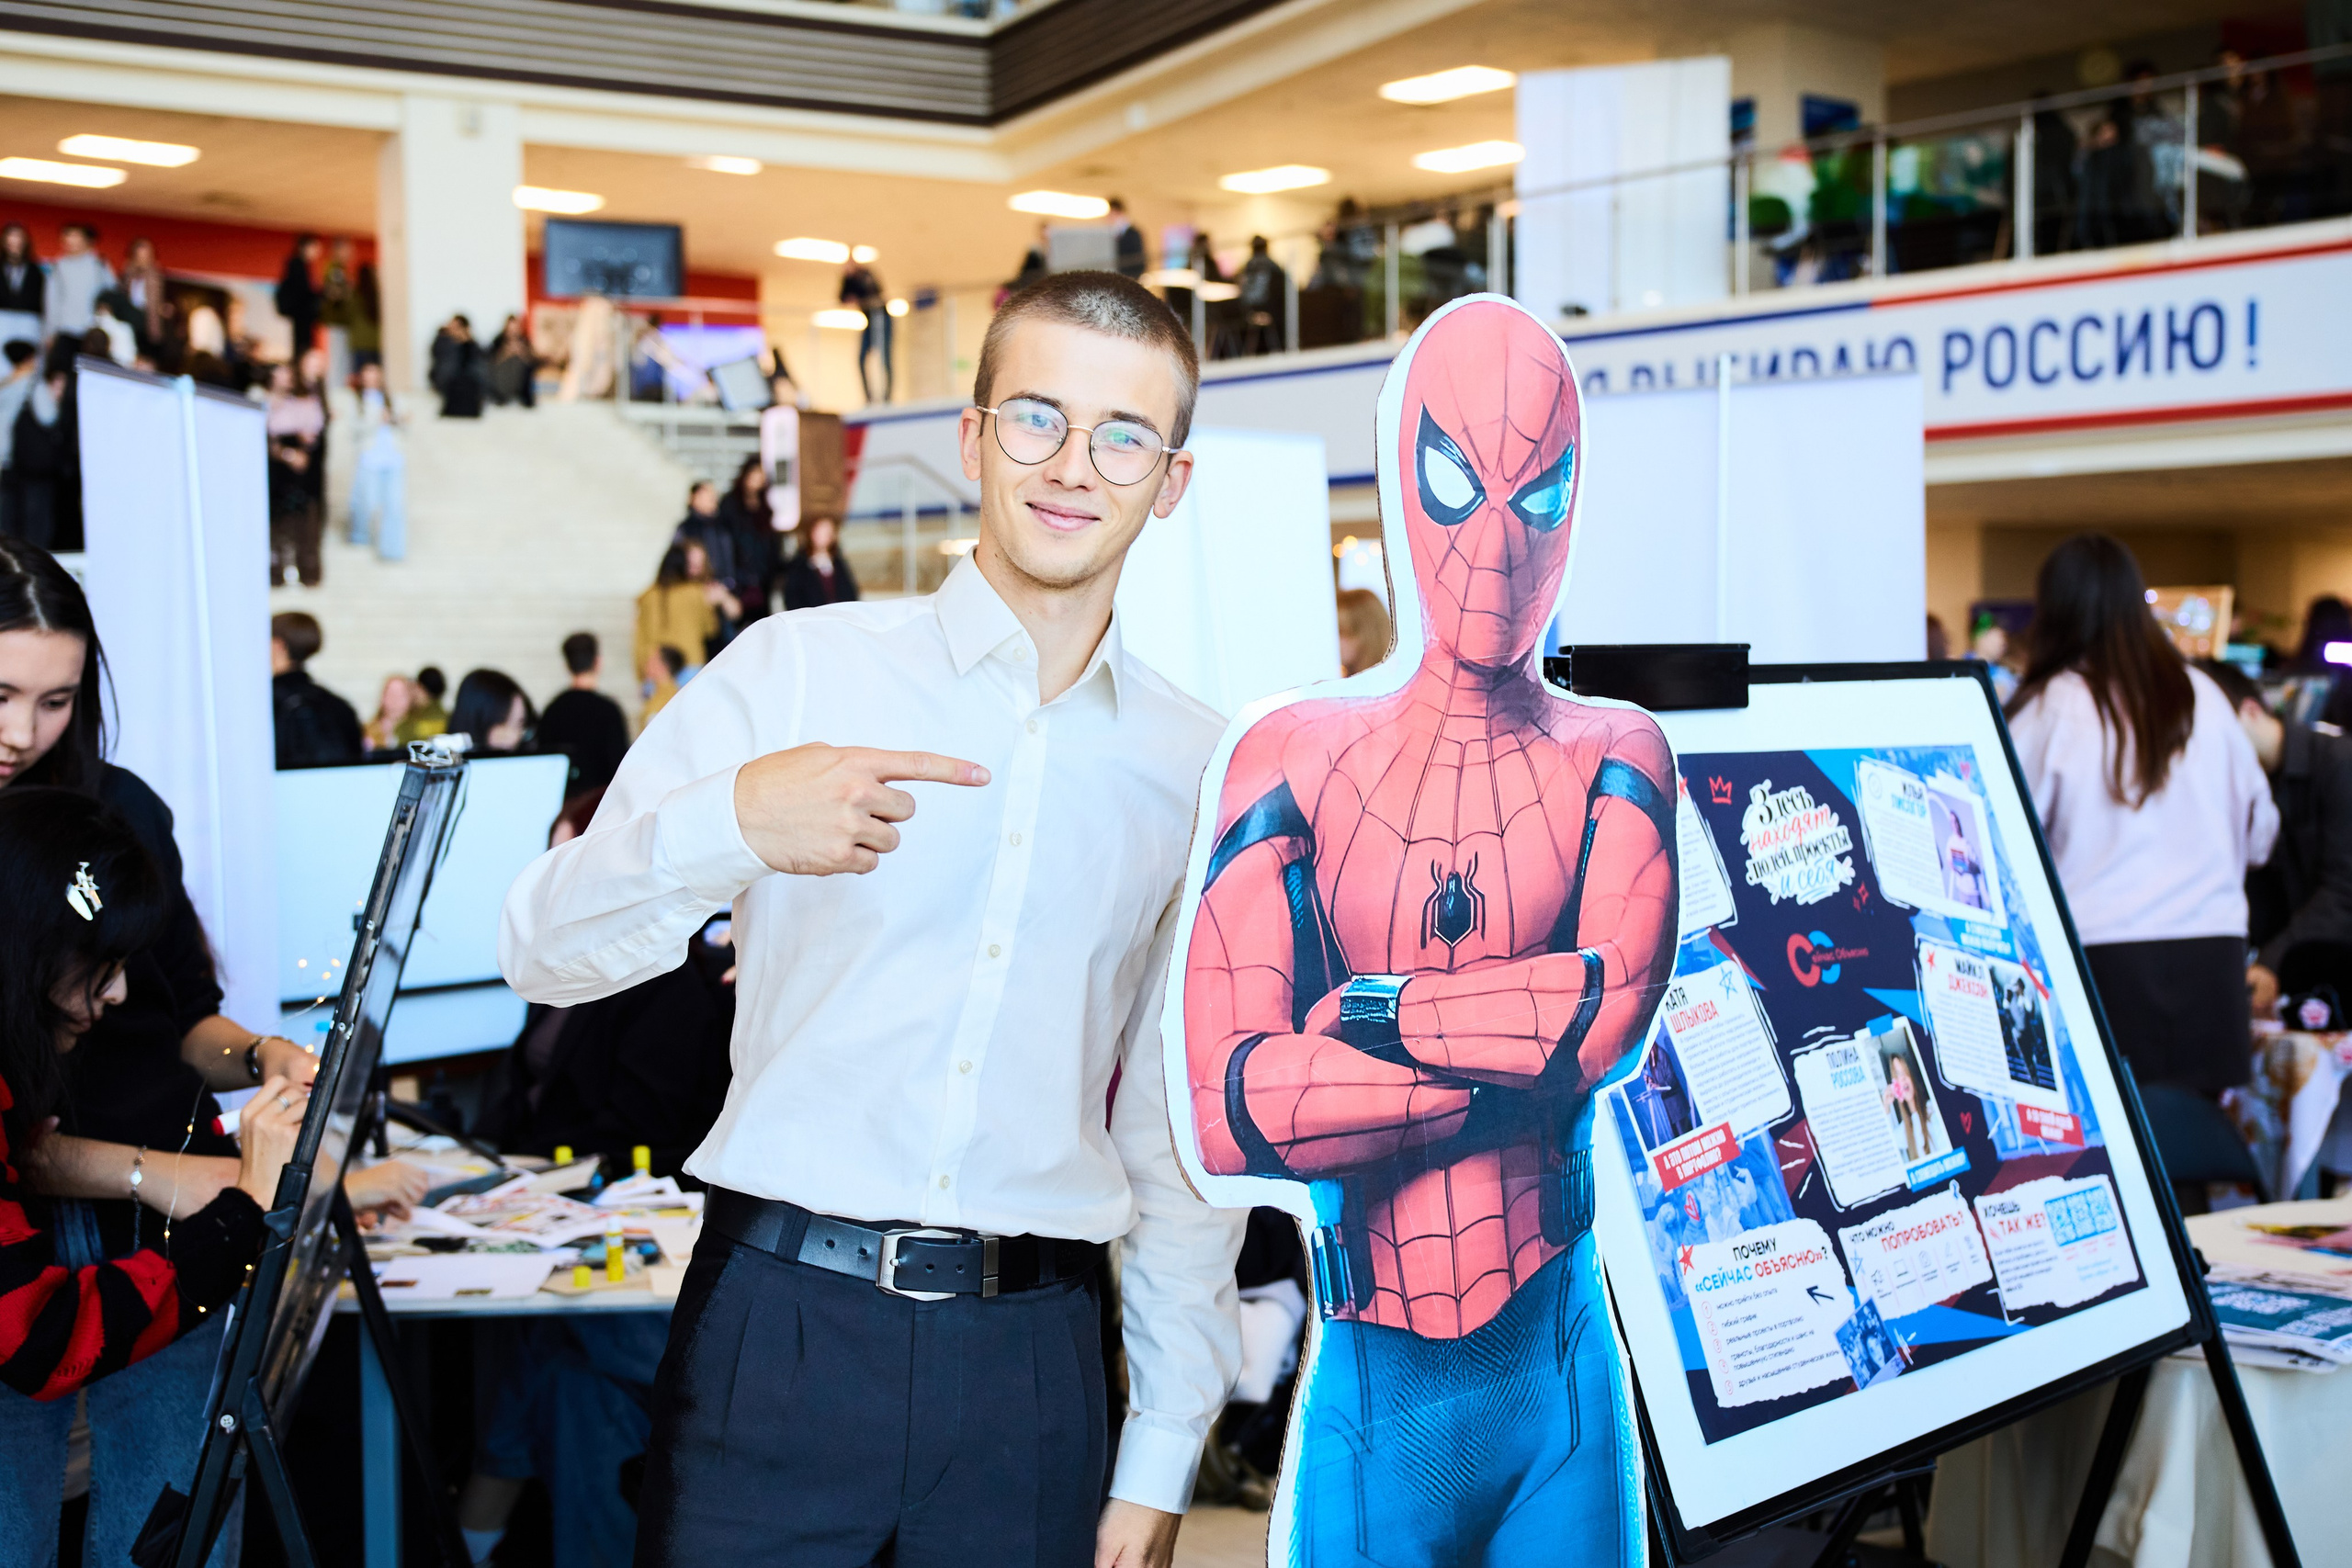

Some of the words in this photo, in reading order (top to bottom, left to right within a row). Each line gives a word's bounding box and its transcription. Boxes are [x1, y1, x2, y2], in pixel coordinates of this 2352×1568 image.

[1781, 874, 1792, 894] и
[1798, 856, 1838, 890] себя
[1670, 1000, 1719, 1033] ШЛЫКОВА
[1983, 1201, 2020, 1218] ХОЧЕШЬ
[1849, 1233, 1865, 1244] ЧТО
[1866, 1221, 1895, 1239] МОЖНО
[1882, 1211, 1965, 1253] ПОПРОБОВАТЬ?
[1998, 1216, 2021, 1235] ТАК
[1733, 1237, 1777, 1261] ПОЧЕМУ
[1695, 1266, 1753, 1292] «СЕЙЧАС
[1755, 1246, 1828, 1278] ОБЪЯСНЮ»?
